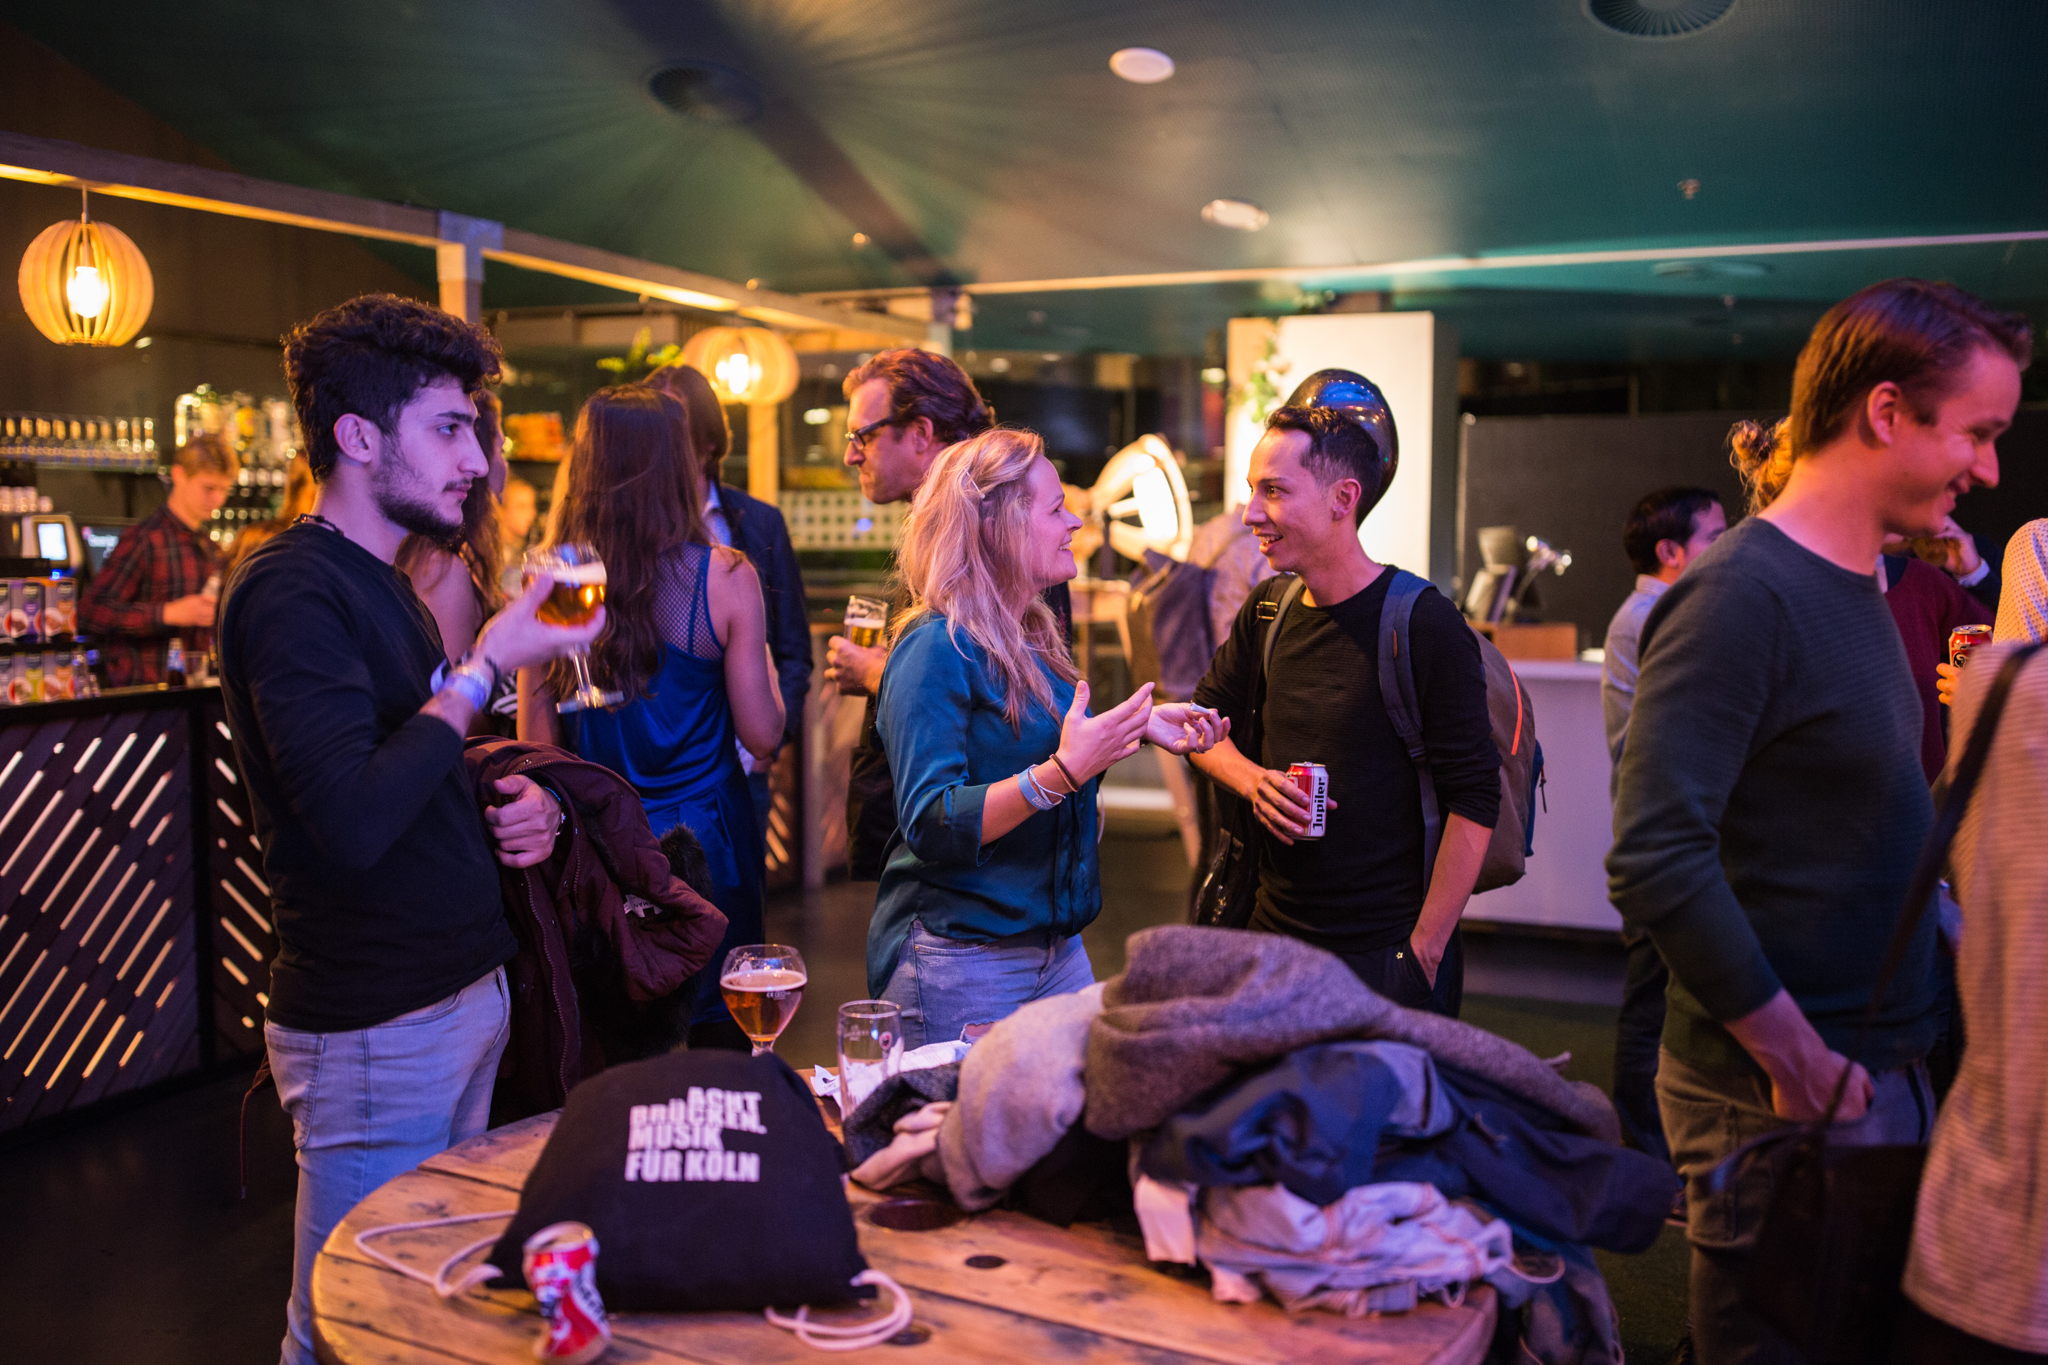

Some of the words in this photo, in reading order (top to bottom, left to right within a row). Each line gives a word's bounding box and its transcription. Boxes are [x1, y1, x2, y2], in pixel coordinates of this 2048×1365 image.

[1312, 777, 1326, 832] Jupiler
[628, 1123, 725, 1151] MUSIK
[624, 1147, 683, 1182] FÜR
[684, 1147, 760, 1182] KÖLN
